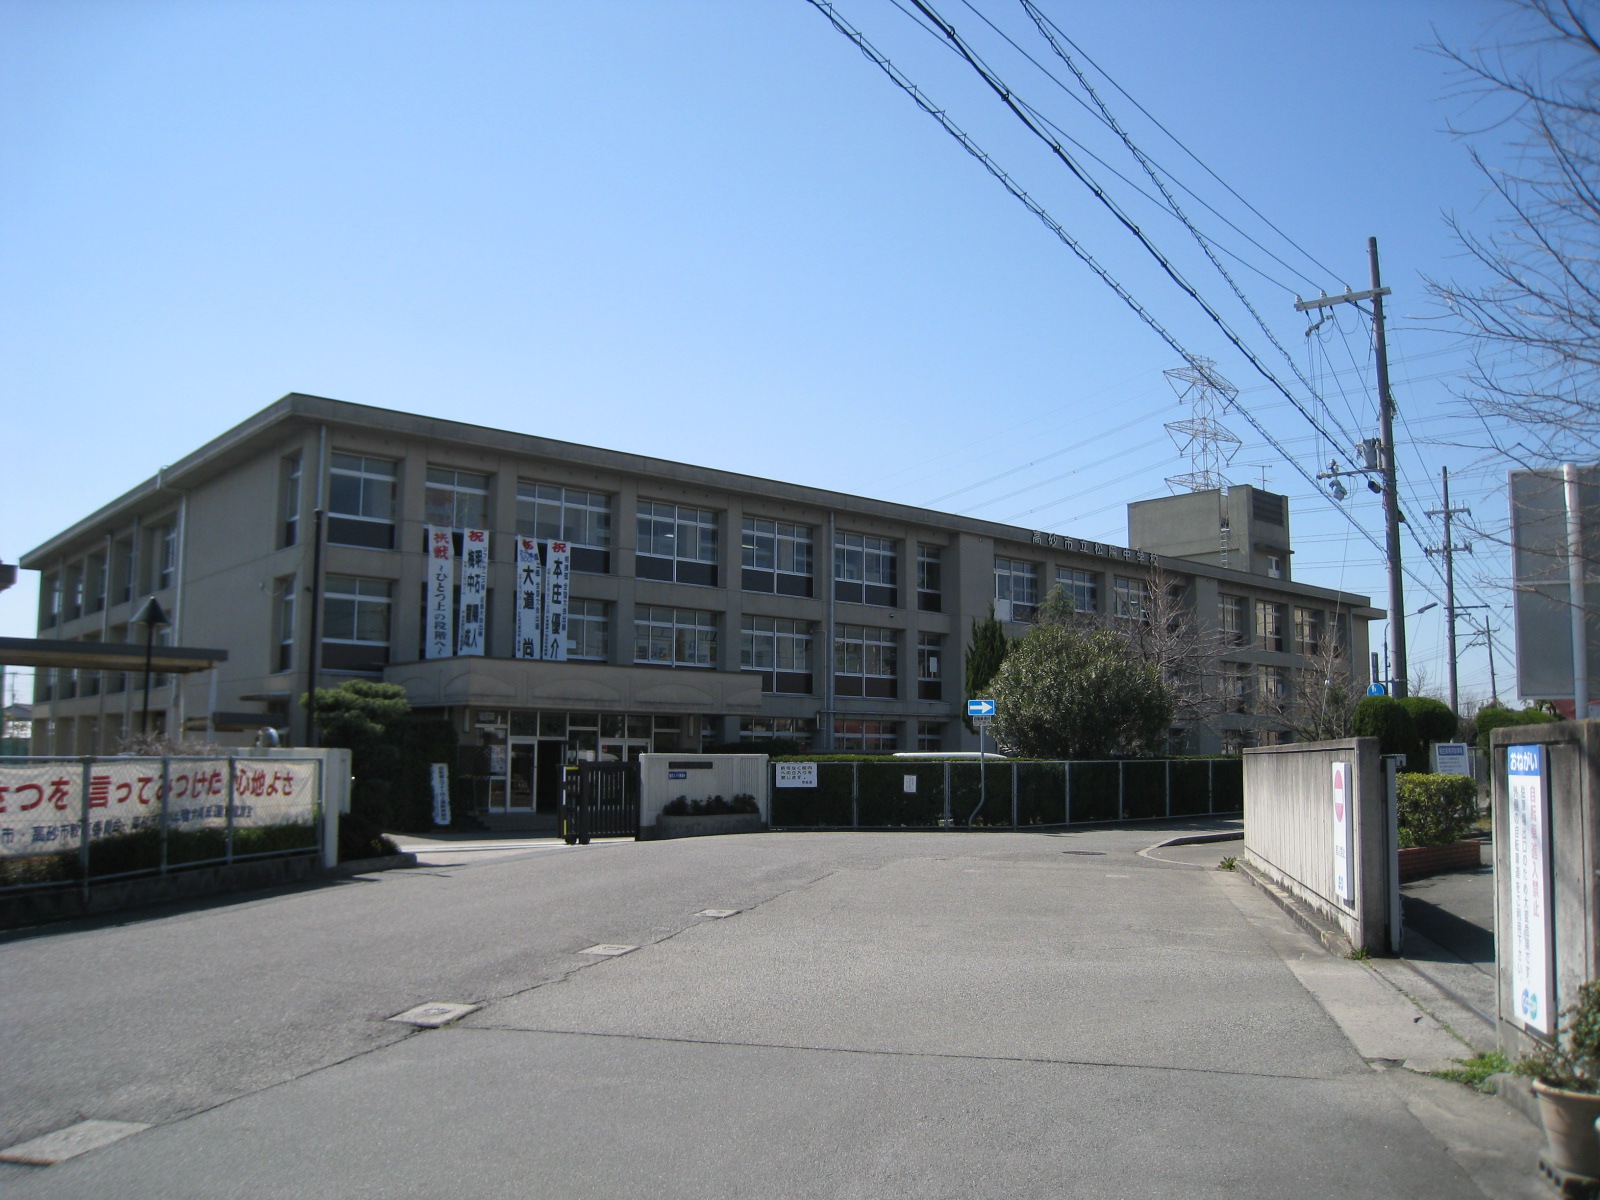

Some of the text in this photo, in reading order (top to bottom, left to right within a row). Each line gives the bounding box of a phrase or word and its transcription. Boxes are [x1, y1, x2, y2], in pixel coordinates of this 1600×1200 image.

[468, 530, 484, 542] 祝
[552, 542, 567, 553] 祝
[1510, 752, 1538, 772] おねがい
